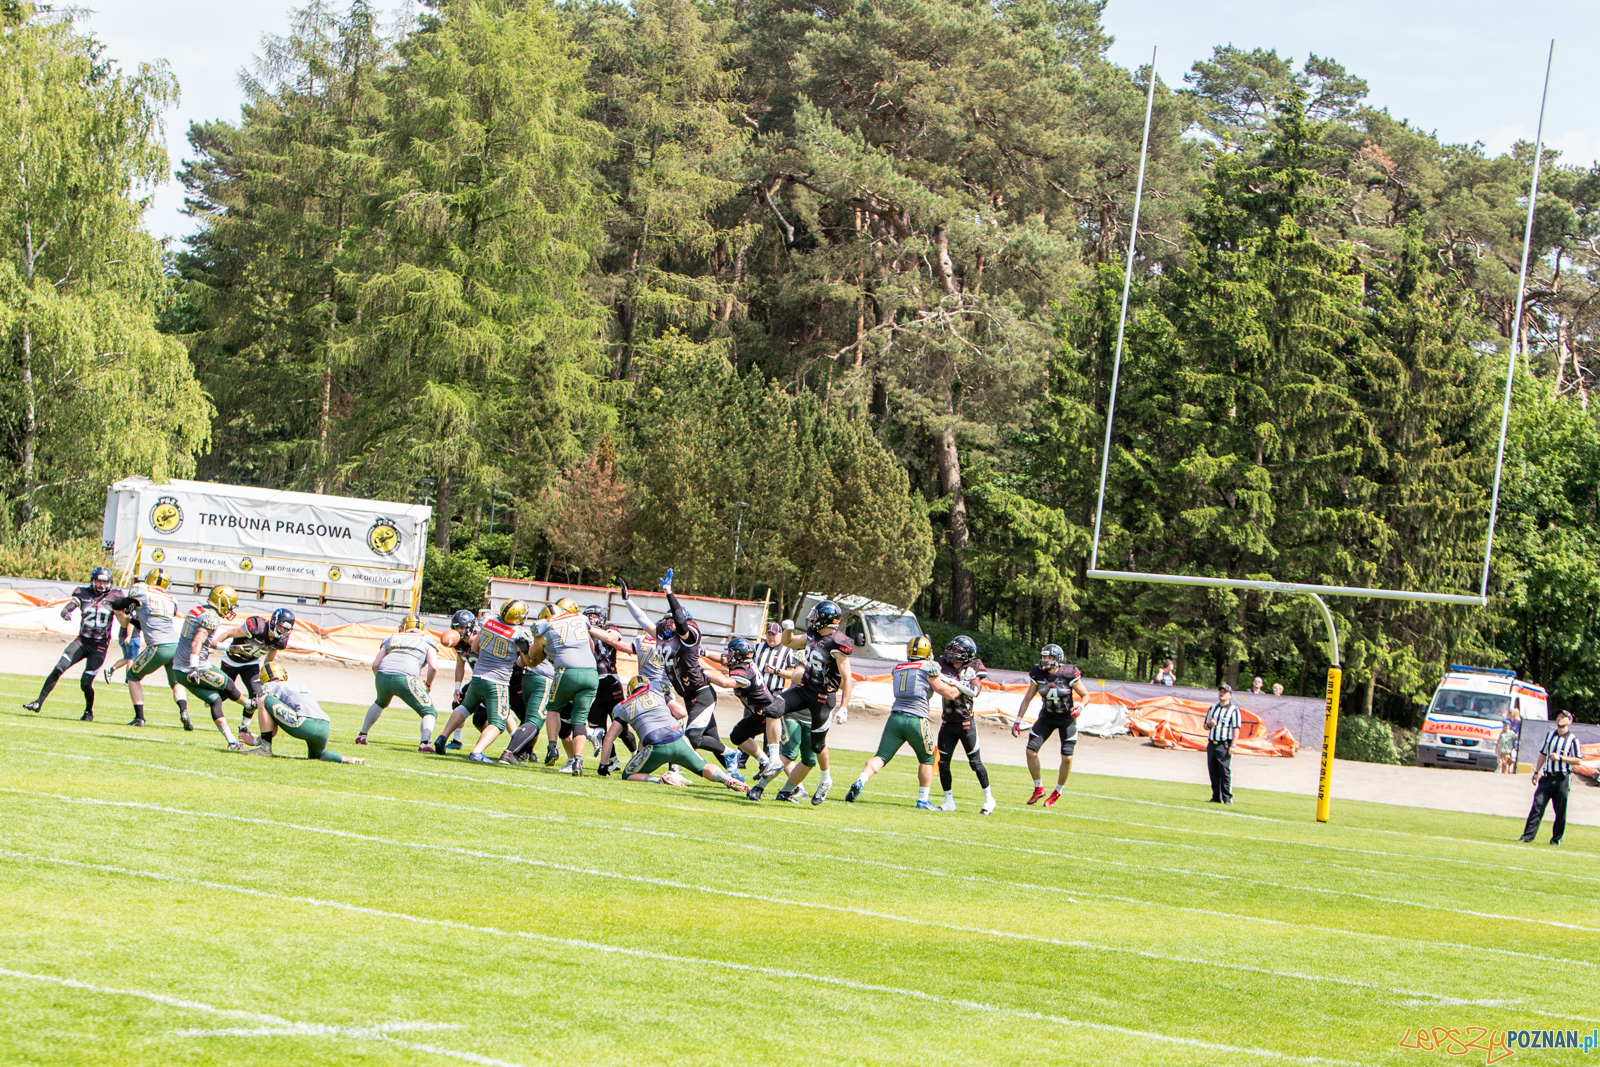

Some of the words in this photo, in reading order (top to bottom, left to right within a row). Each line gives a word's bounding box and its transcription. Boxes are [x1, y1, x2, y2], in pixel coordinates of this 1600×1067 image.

[199, 512, 271, 532] TRYBUNA
[275, 520, 352, 540] PRASOWA
[188, 557, 216, 566] OPIERAĆ
[217, 560, 227, 568] SIĘ
[277, 565, 305, 574] OPIERAĆ
[305, 569, 315, 577] SIĘ
[363, 575, 391, 584] OPIERAĆ
[392, 577, 402, 585] SIĘ
[83, 607, 111, 628] 20
[480, 629, 509, 659] 70
[552, 619, 590, 646] 72
[899, 669, 909, 692] 1
[623, 690, 661, 721] 78
[1046, 688, 1060, 704] 4
[1325, 681, 1334, 721] SPORT
[1318, 735, 1329, 801] TRANSFER
